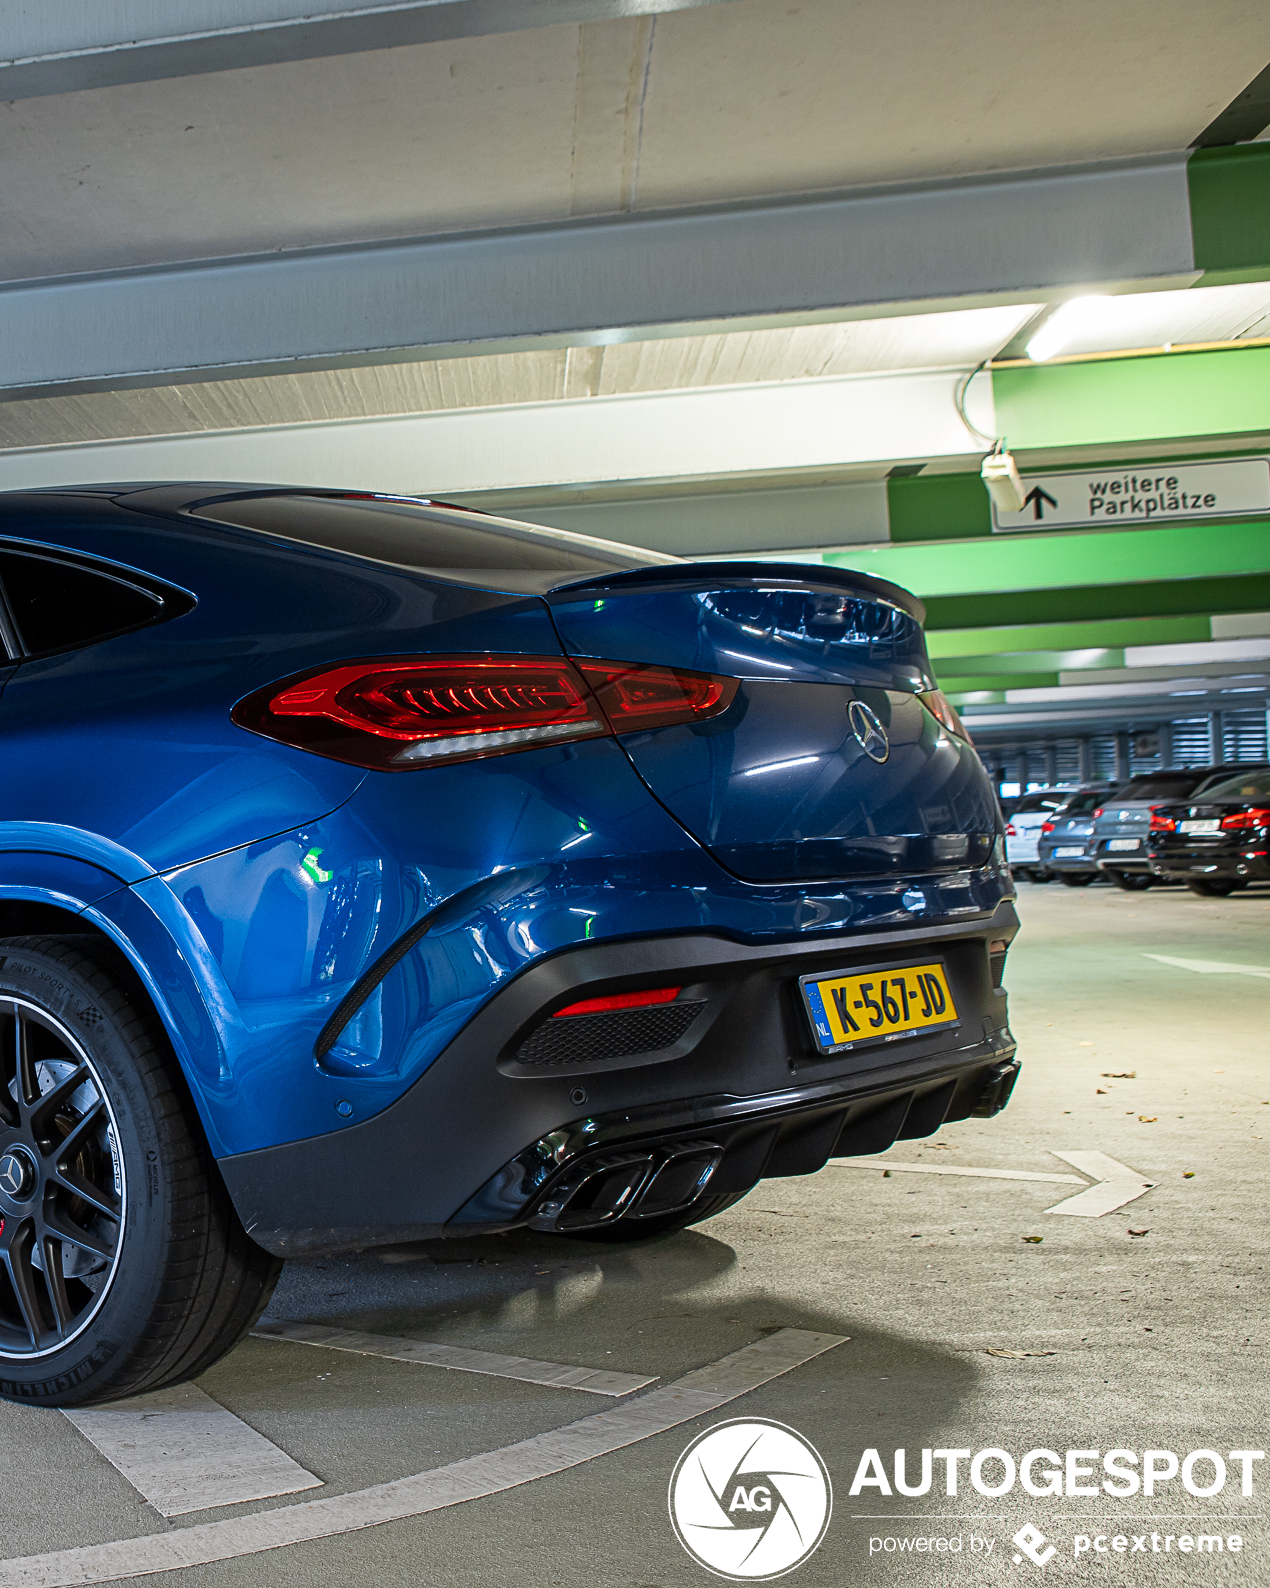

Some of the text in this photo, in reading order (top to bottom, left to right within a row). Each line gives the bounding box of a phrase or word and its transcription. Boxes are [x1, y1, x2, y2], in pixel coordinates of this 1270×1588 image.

[1088, 475, 1179, 496] weitere
[1089, 491, 1217, 518] Parkplätze
[10, 961, 38, 977] PILOT
[39, 971, 70, 996] SPORT
[831, 973, 946, 1034] K-567-JD
[815, 1022, 830, 1036] NL
[1, 1360, 94, 1396] MICHELIN
